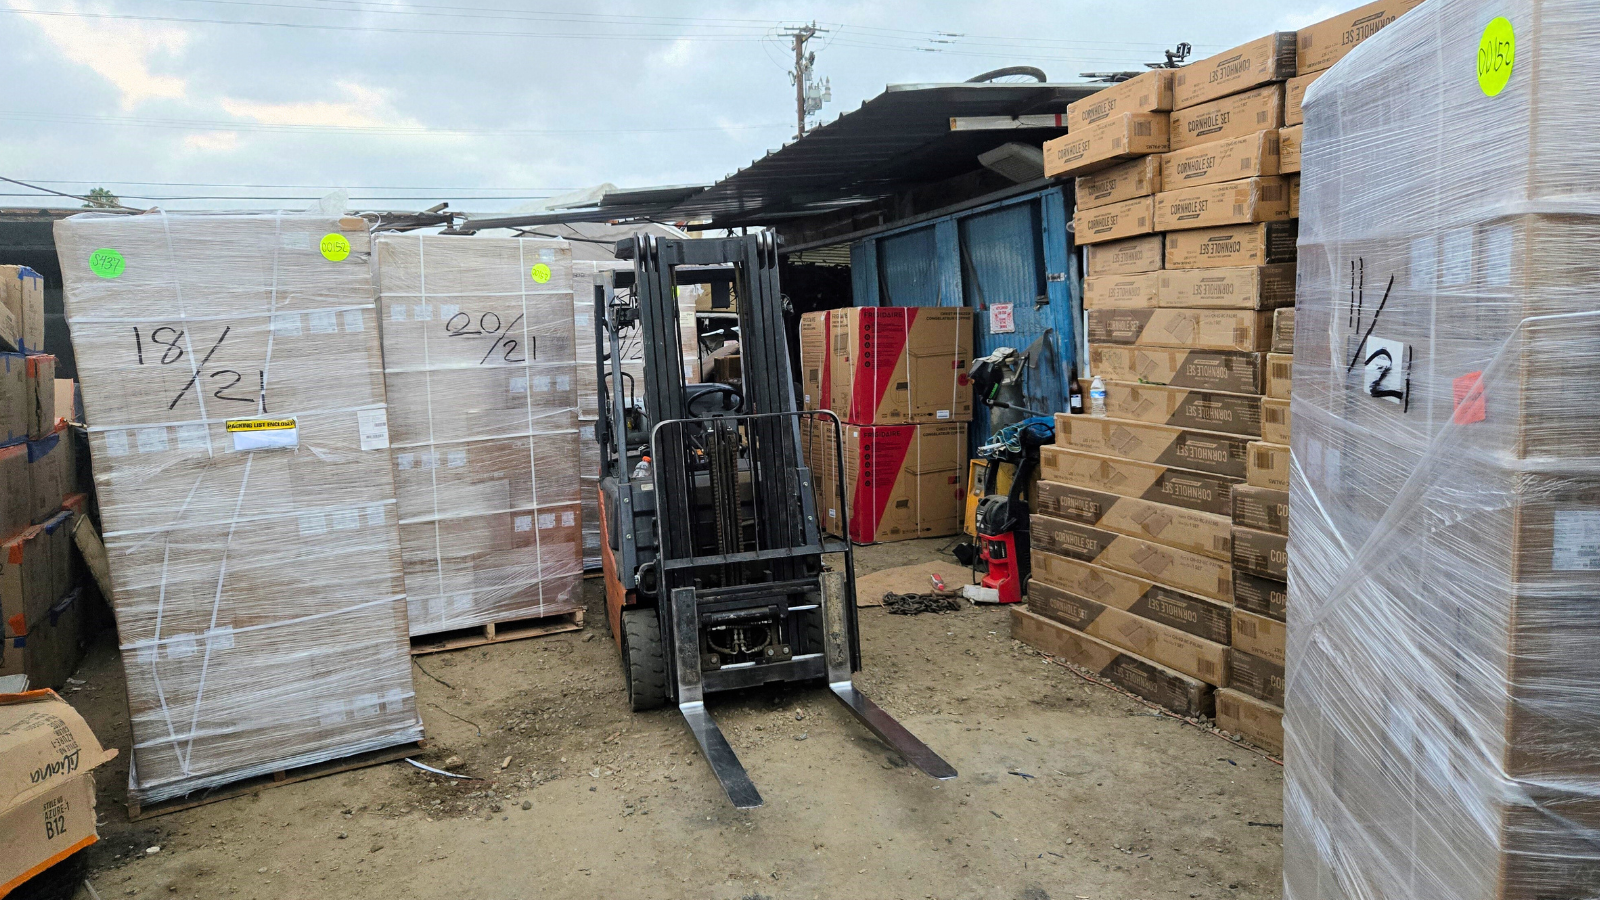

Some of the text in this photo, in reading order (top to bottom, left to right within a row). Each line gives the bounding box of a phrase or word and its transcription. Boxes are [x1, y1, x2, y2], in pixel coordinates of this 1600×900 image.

[1341, 29, 1354, 46] SET
[1208, 58, 1251, 84] CORNHOLE SET
[1082, 98, 1117, 121] CORNHOLE SET
[1188, 114, 1219, 132] CORNHOLE
[1220, 112, 1230, 125] SET
[1058, 140, 1090, 160] CORNHOLE SET
[1177, 159, 1206, 175] CORNHOLE
[1206, 156, 1216, 169] SET
[1170, 200, 1208, 216] CORNHOLE SET
[1088, 214, 1118, 230] CORNHOLE SET
[321, 241, 348, 253] 00152
[1199, 241, 1240, 254] CORNHOLE SET
[92, 253, 120, 272] S437
[1112, 250, 1142, 264] CORNHOLE SET
[1108, 286, 1140, 298] CORNHOLE SET
[1192, 283, 1234, 296] CORNHOLE SET
[1107, 320, 1139, 331] CORNHOLE SET
[1186, 364, 1228, 379] CORNHOLE SET
[1185, 406, 1232, 422] CORNHOLE SET
[227, 422, 252, 430] PACKING
[1176, 446, 1227, 463] CORNHOLE SET
[1162, 486, 1212, 502] CORNHOLE SET
[1060, 496, 1100, 514] CORNHOLE SET
[1054, 530, 1086, 548] CORNHOLE
[1086, 537, 1098, 550] SET
[1049, 598, 1088, 620] CORNHOLE SET
[1148, 598, 1198, 623] CORNHOLE SET
[1113, 665, 1158, 693] CORNHOLE SET
[50, 732, 74, 748] AZURE-1
[44, 798, 56, 811] STYLE
[44, 801, 70, 822] AZURE-1
[46, 815, 66, 840] B12
